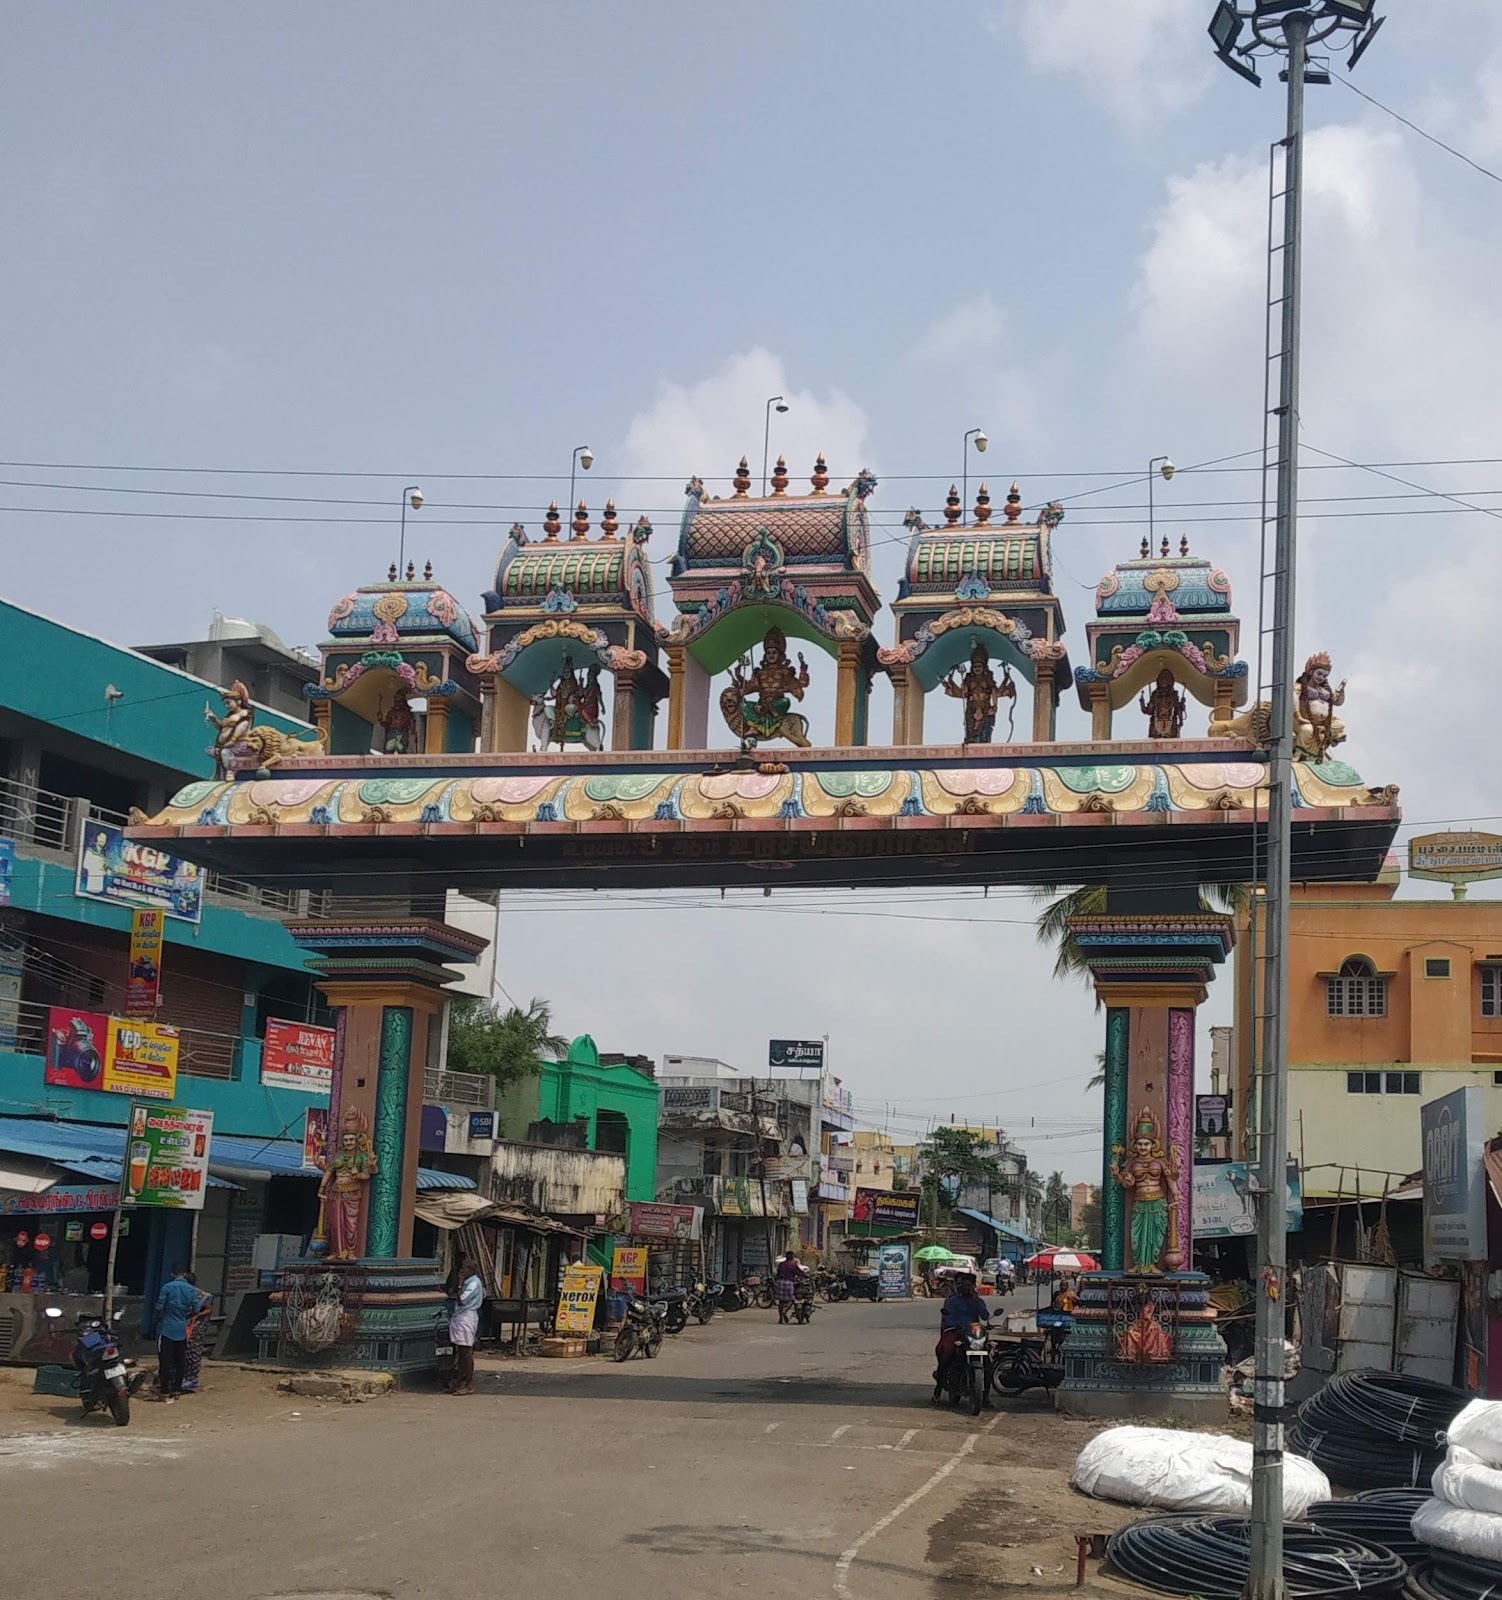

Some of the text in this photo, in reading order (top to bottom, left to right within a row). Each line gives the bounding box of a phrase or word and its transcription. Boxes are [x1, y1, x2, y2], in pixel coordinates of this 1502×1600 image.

[140, 912, 156, 928] KGP
[786, 1041, 822, 1059] சத்யா
[479, 1117, 493, 1127] SBI
[1426, 1119, 1461, 1187] ORBIT
[876, 1195, 918, 1209] தங்கமகள்
[620, 1251, 639, 1264] KGP
[561, 1291, 596, 1303] xerox
